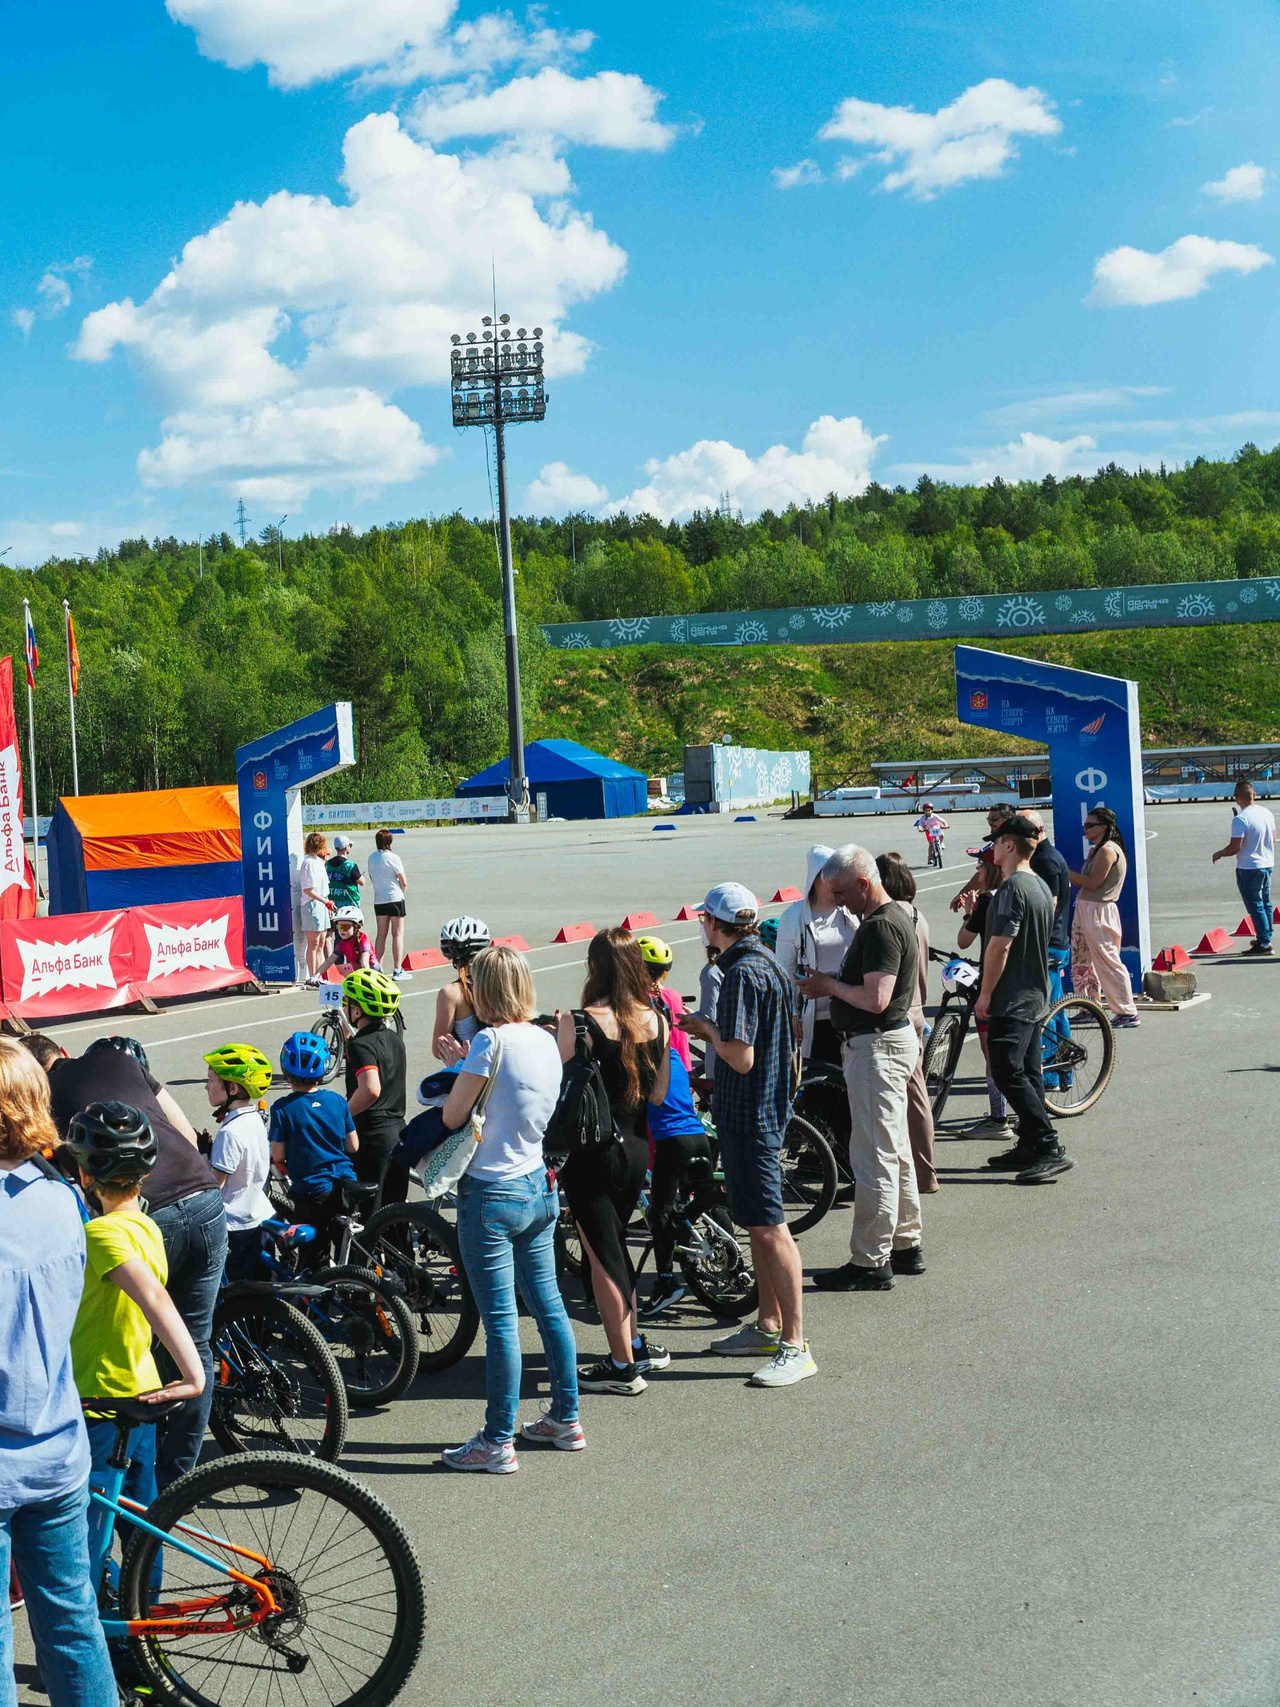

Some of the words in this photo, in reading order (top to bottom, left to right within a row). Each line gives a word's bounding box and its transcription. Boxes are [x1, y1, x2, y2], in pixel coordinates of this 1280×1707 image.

[1, 811, 16, 872] Альфа
[253, 810, 279, 932] ФИНИШ
[157, 940, 192, 957] Альфа
[194, 937, 220, 952] Банк
[32, 957, 72, 975] Альфа
[74, 954, 104, 969] Банк
[944, 966, 972, 979] 117
[325, 991, 339, 1001] 15
